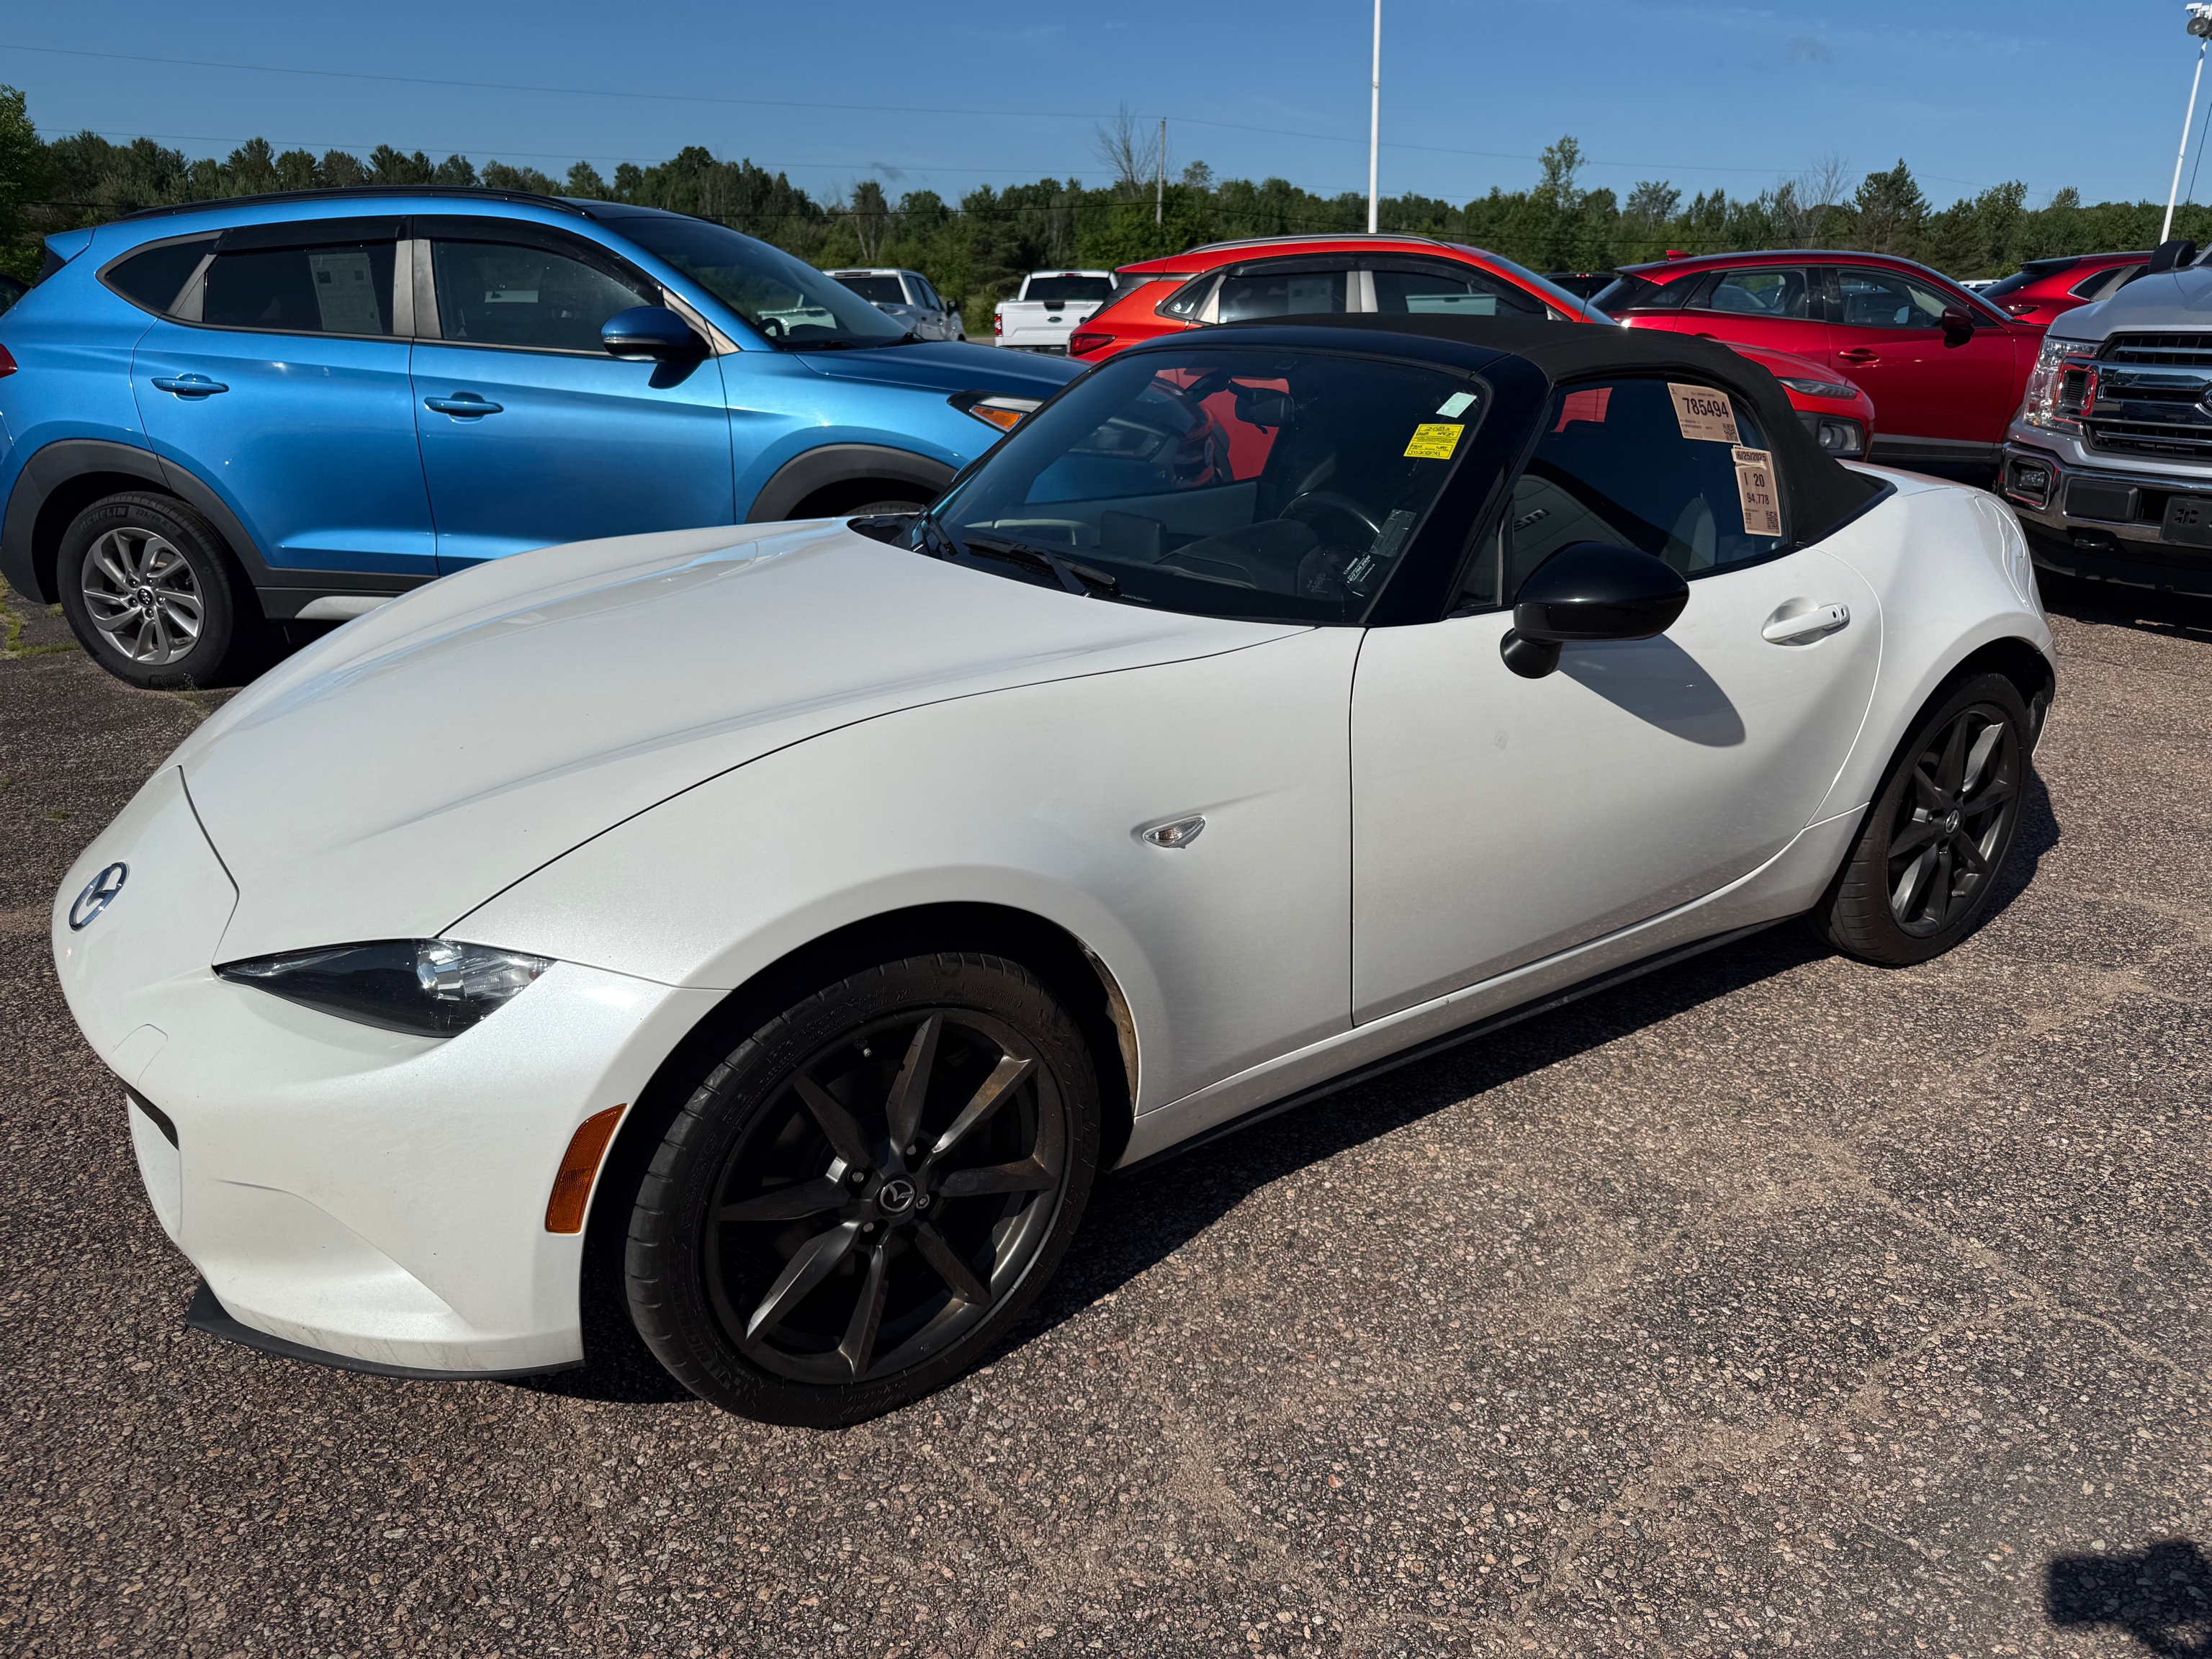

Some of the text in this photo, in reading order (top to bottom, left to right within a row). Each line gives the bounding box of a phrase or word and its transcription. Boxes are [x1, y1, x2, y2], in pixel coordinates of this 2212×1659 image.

[1682, 397, 1729, 418] 785494
[1753, 473, 1765, 487] 20
[1747, 492, 1769, 505] 94,778
[135, 508, 161, 523] 225/60
